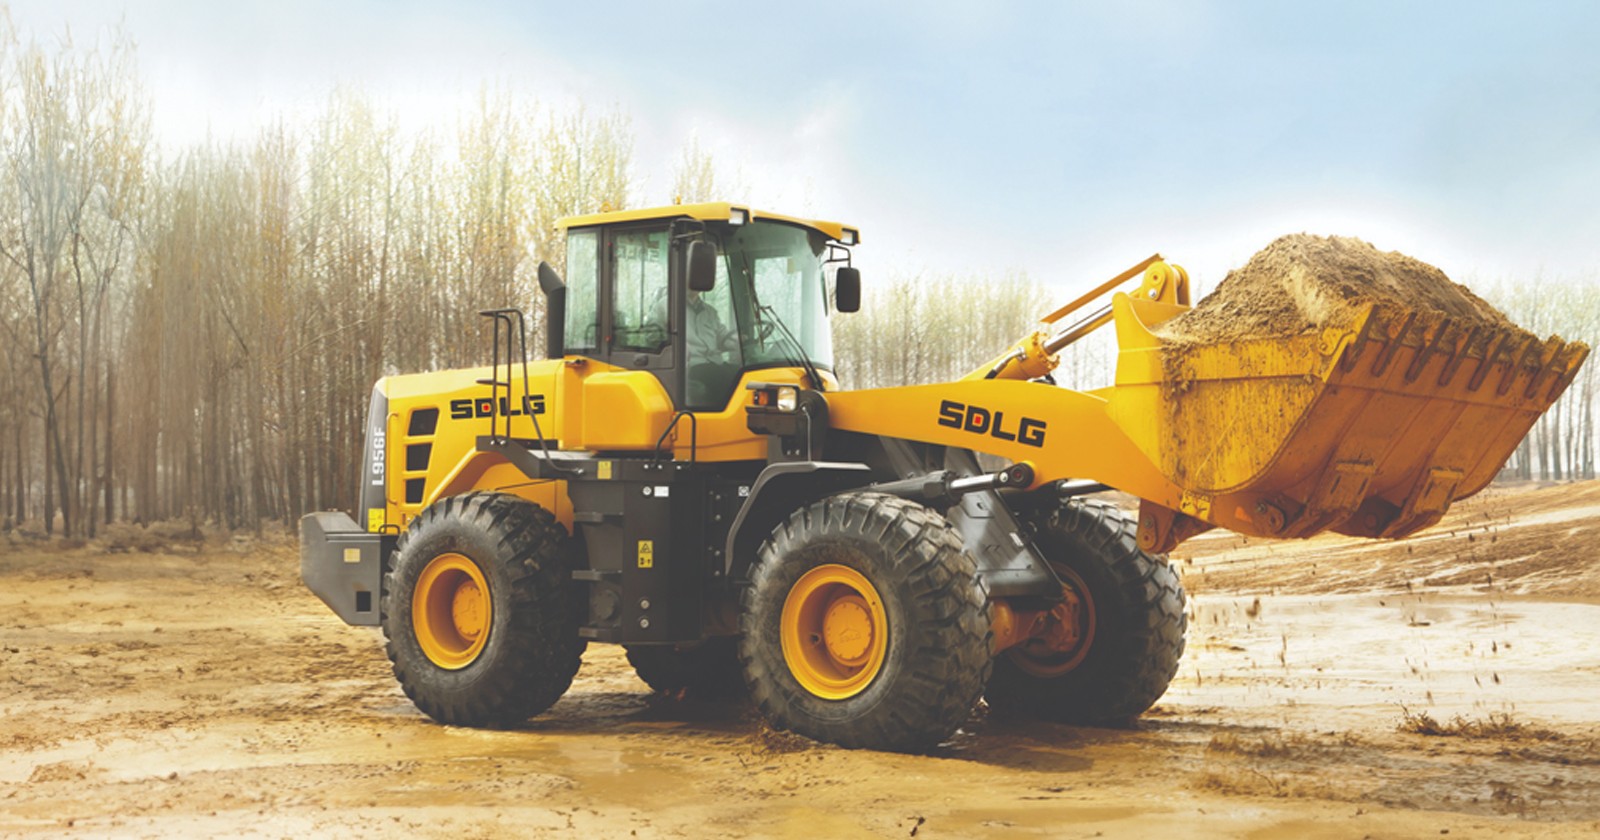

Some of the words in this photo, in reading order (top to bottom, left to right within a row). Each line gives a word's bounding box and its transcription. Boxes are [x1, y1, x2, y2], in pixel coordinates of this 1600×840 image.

[450, 395, 545, 419] SDLG
[938, 399, 1047, 448] SDLG
[371, 426, 386, 486] L956F
